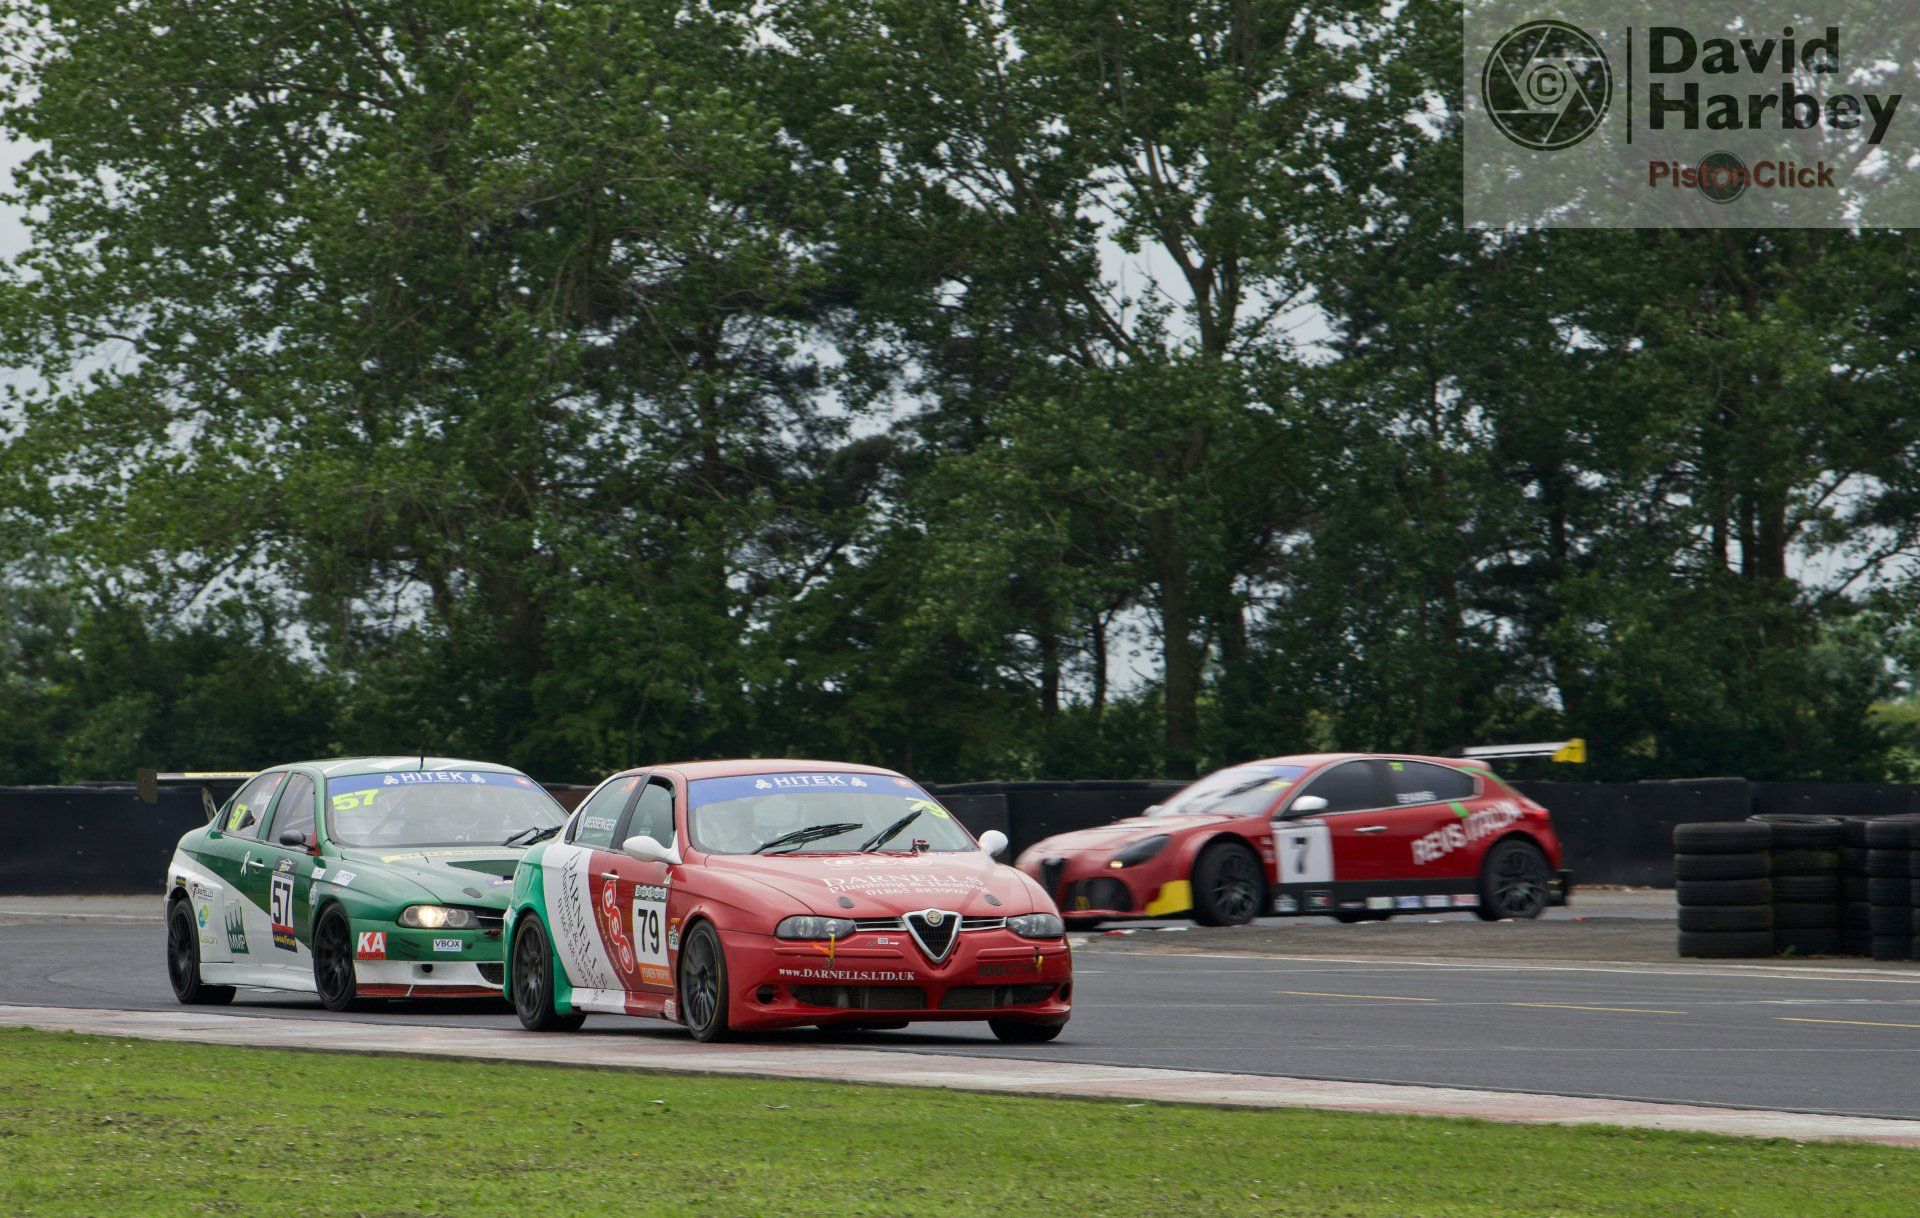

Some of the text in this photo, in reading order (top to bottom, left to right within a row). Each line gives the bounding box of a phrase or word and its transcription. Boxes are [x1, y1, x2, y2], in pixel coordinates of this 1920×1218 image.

[400, 771, 466, 782] HITEK
[773, 775, 846, 786] HITEK
[332, 789, 379, 811] 57
[586, 816, 617, 831] MESSENGER
[1291, 836, 1310, 874] 7
[821, 874, 984, 888] DARNELLS
[828, 881, 904, 894] Plumbing
[929, 880, 991, 894] Heating
[273, 880, 291, 926] 57
[568, 849, 608, 993] DARNELLS
[605, 889, 629, 964] BSS
[637, 909, 660, 955] 79
[357, 932, 386, 952] KA
[435, 940, 463, 949] VBOX
[358, 950, 385, 959] sensors
[778, 967, 916, 981] www.DARNELLS.LTD.UK
